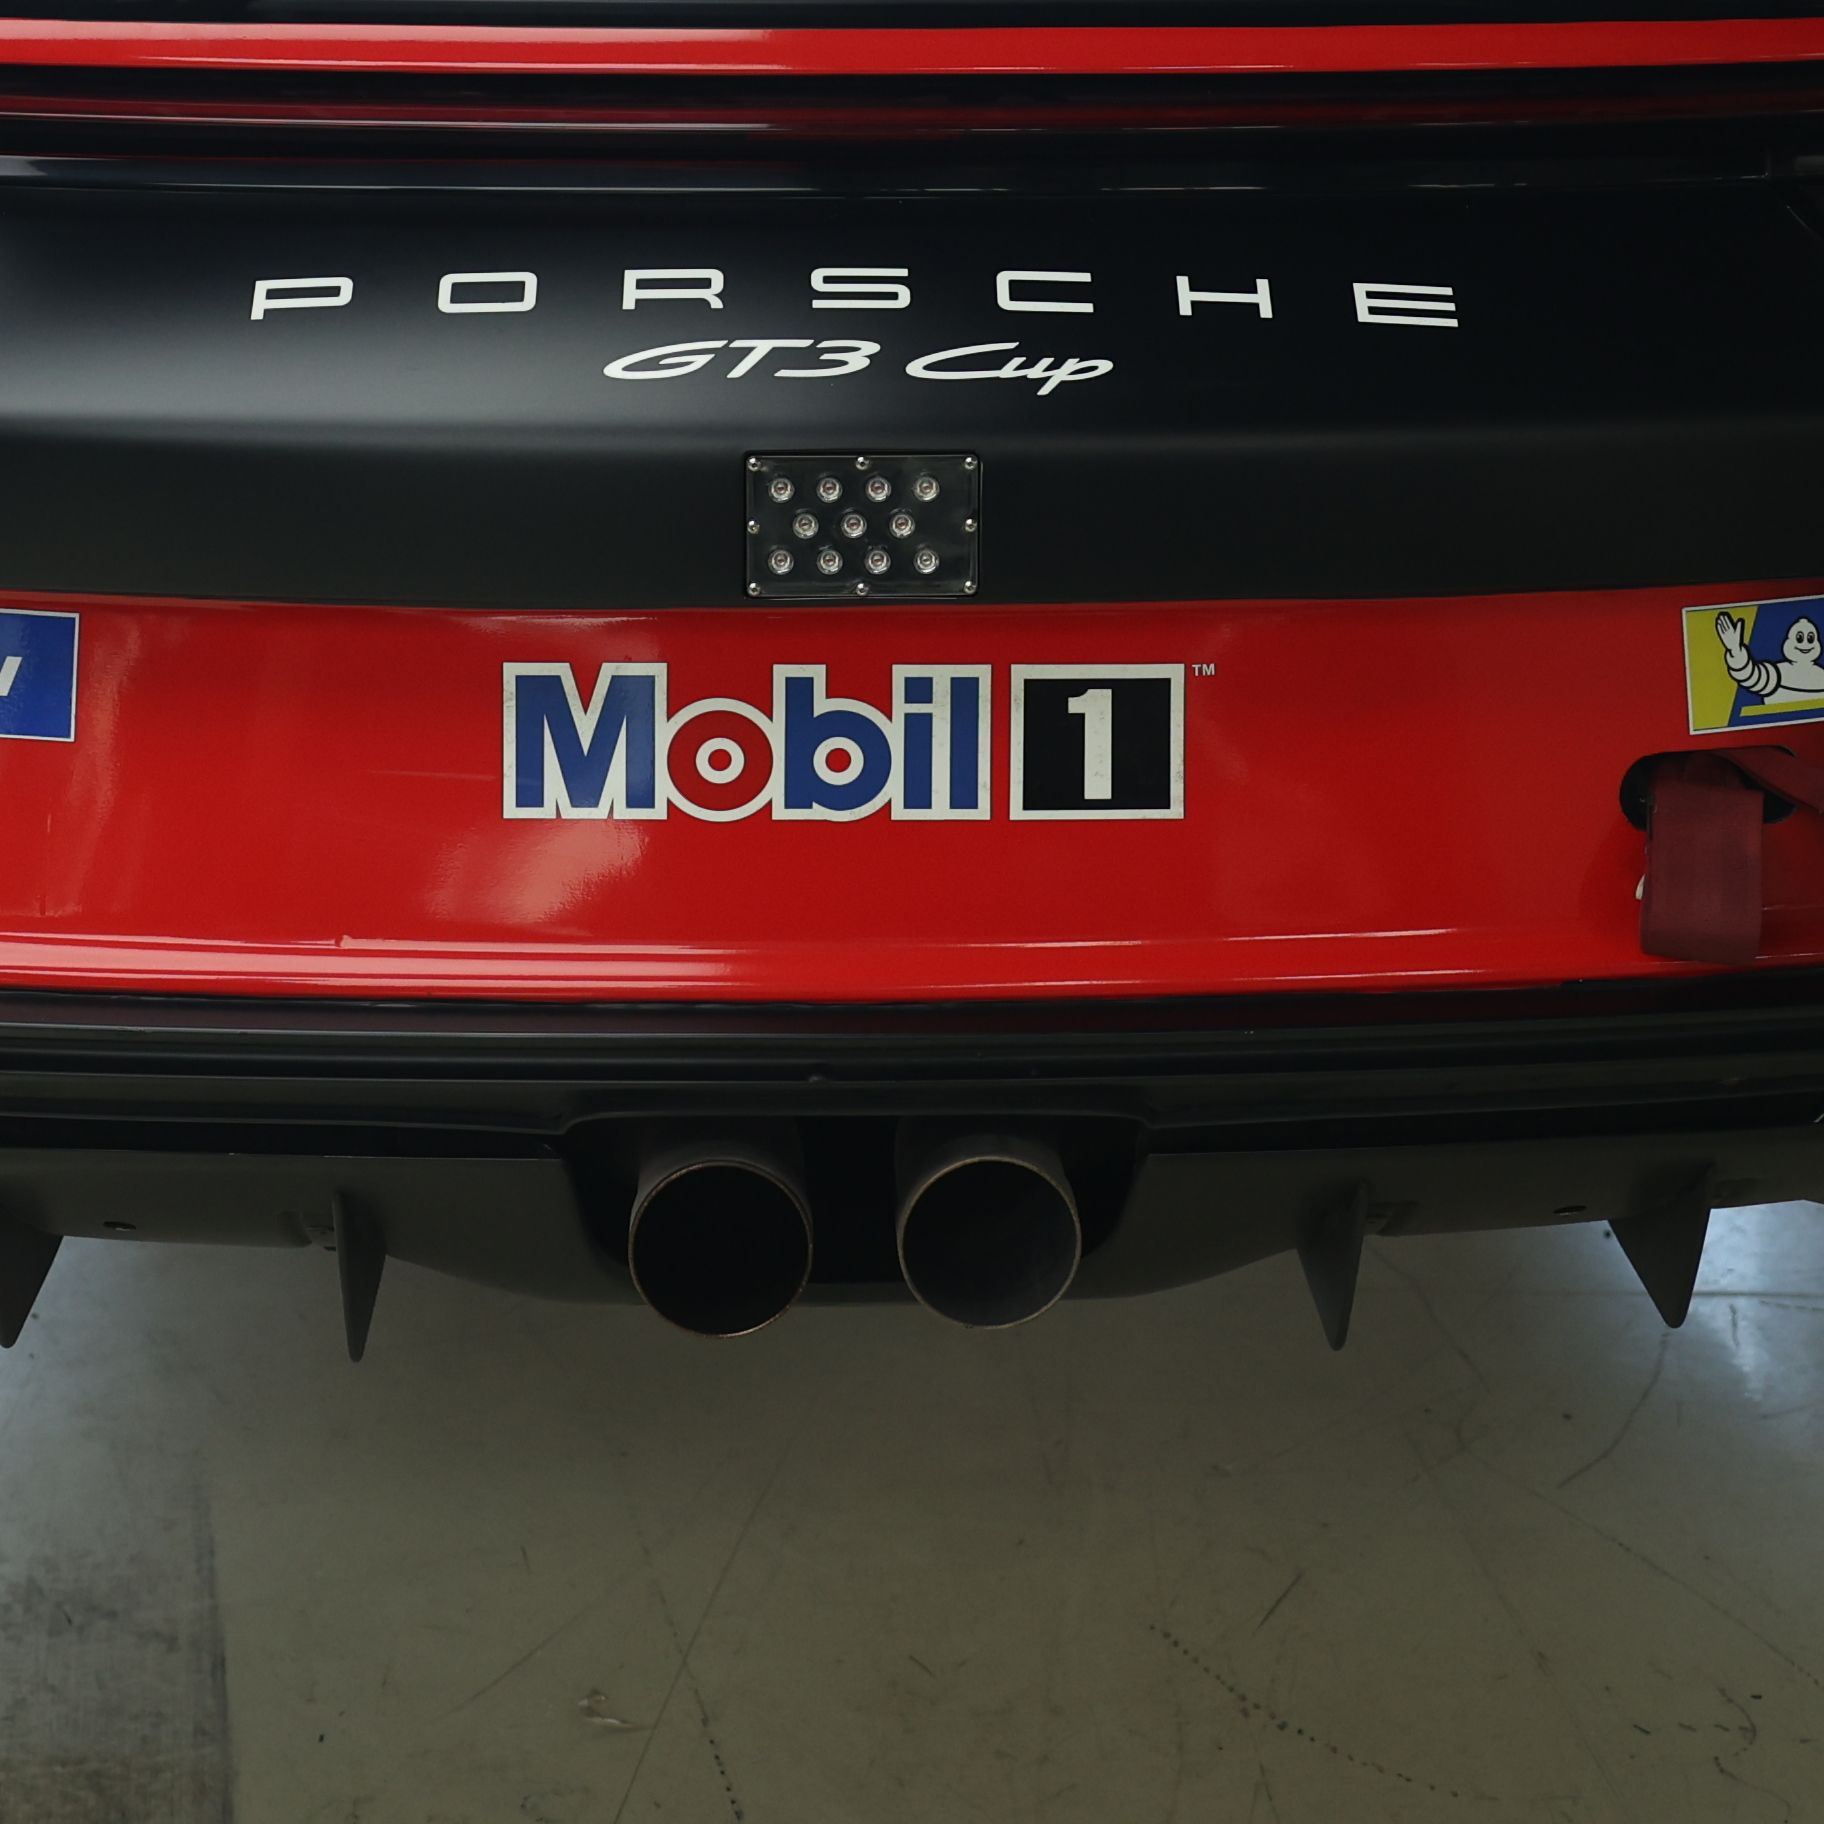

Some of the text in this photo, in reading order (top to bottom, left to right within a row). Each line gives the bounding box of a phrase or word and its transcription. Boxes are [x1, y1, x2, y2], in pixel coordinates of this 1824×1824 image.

[250, 267, 1460, 328] PORSCHE
[602, 338, 1115, 397] GT3 Cup
[503, 662, 992, 822] Mobil
